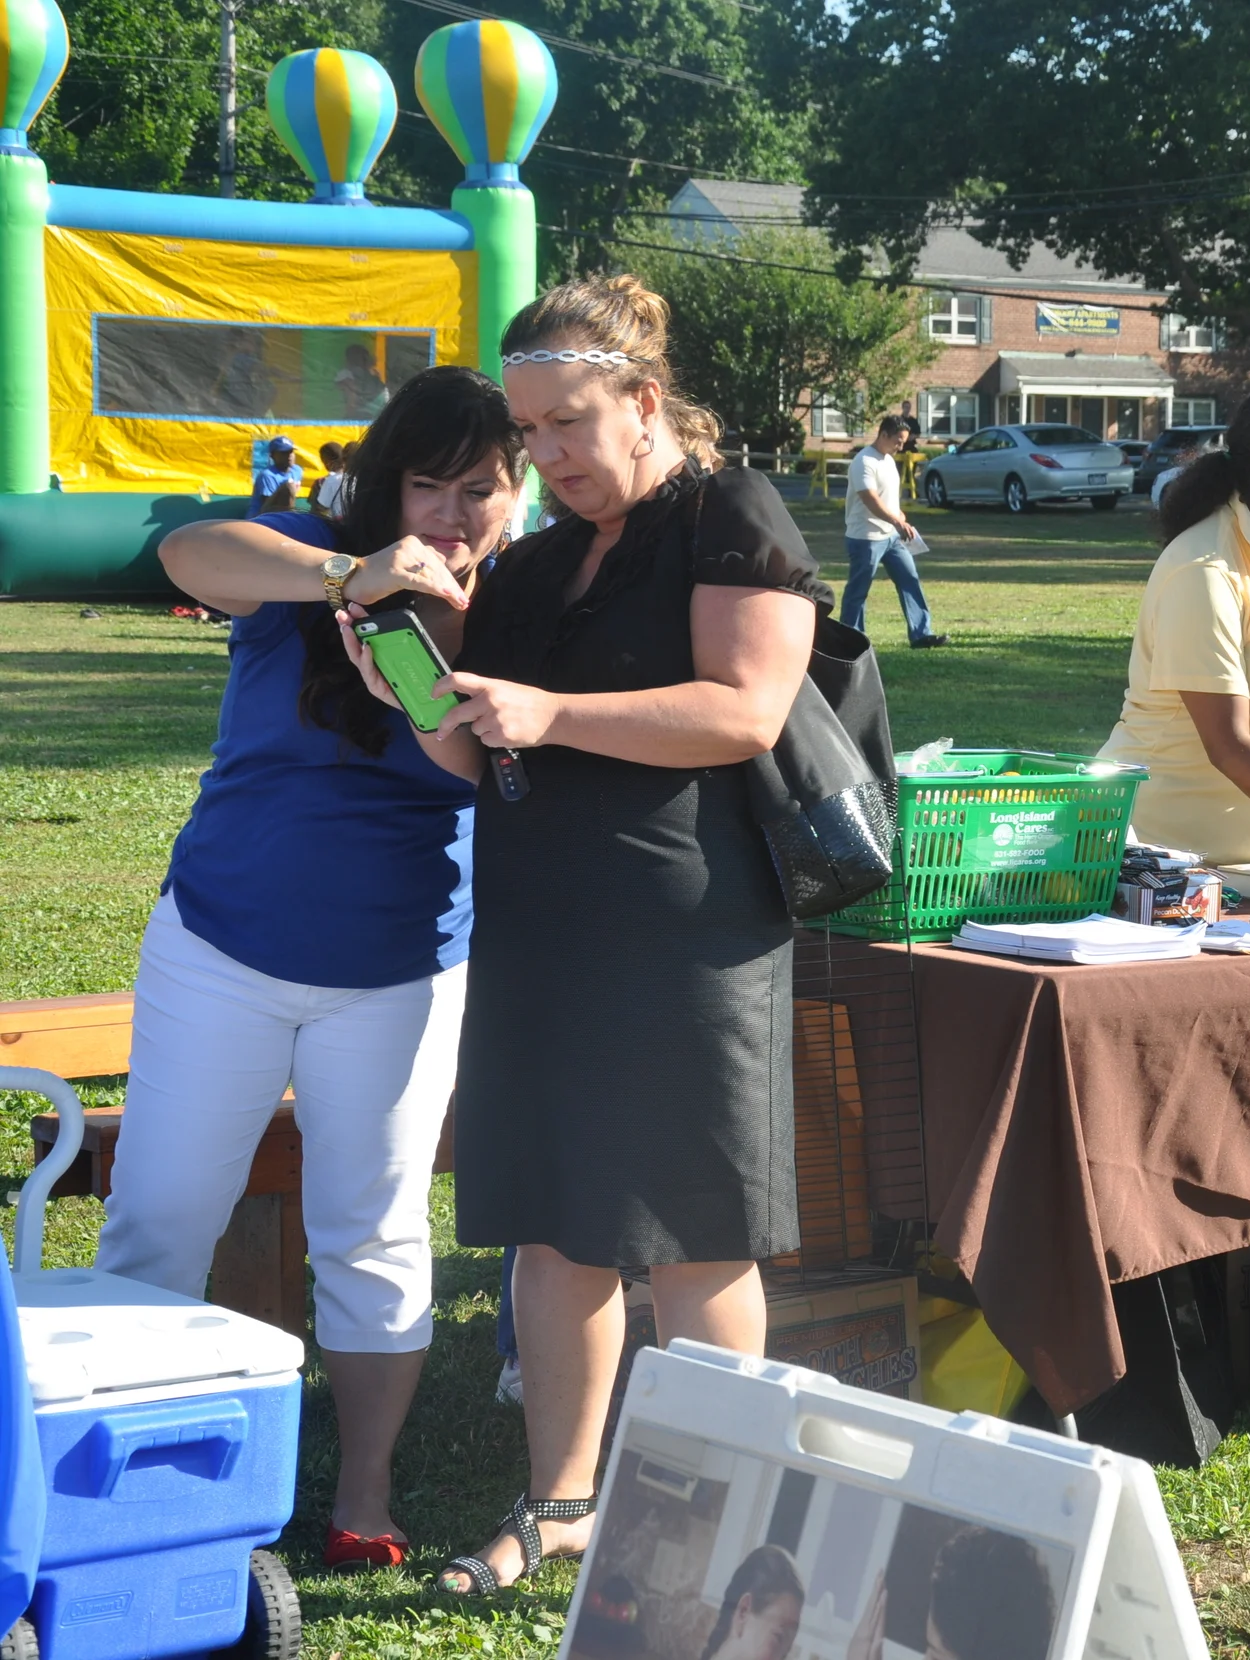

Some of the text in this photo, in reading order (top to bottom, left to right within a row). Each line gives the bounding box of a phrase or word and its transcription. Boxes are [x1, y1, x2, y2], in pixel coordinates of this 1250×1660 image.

[989, 810, 1056, 824] Long Island
[1014, 822, 1048, 834] Cares
[990, 858, 1047, 867] www.licares.org
[1154, 908, 1172, 916] Pecan
[775, 1315, 897, 1347] PREMIUM ORANGES
